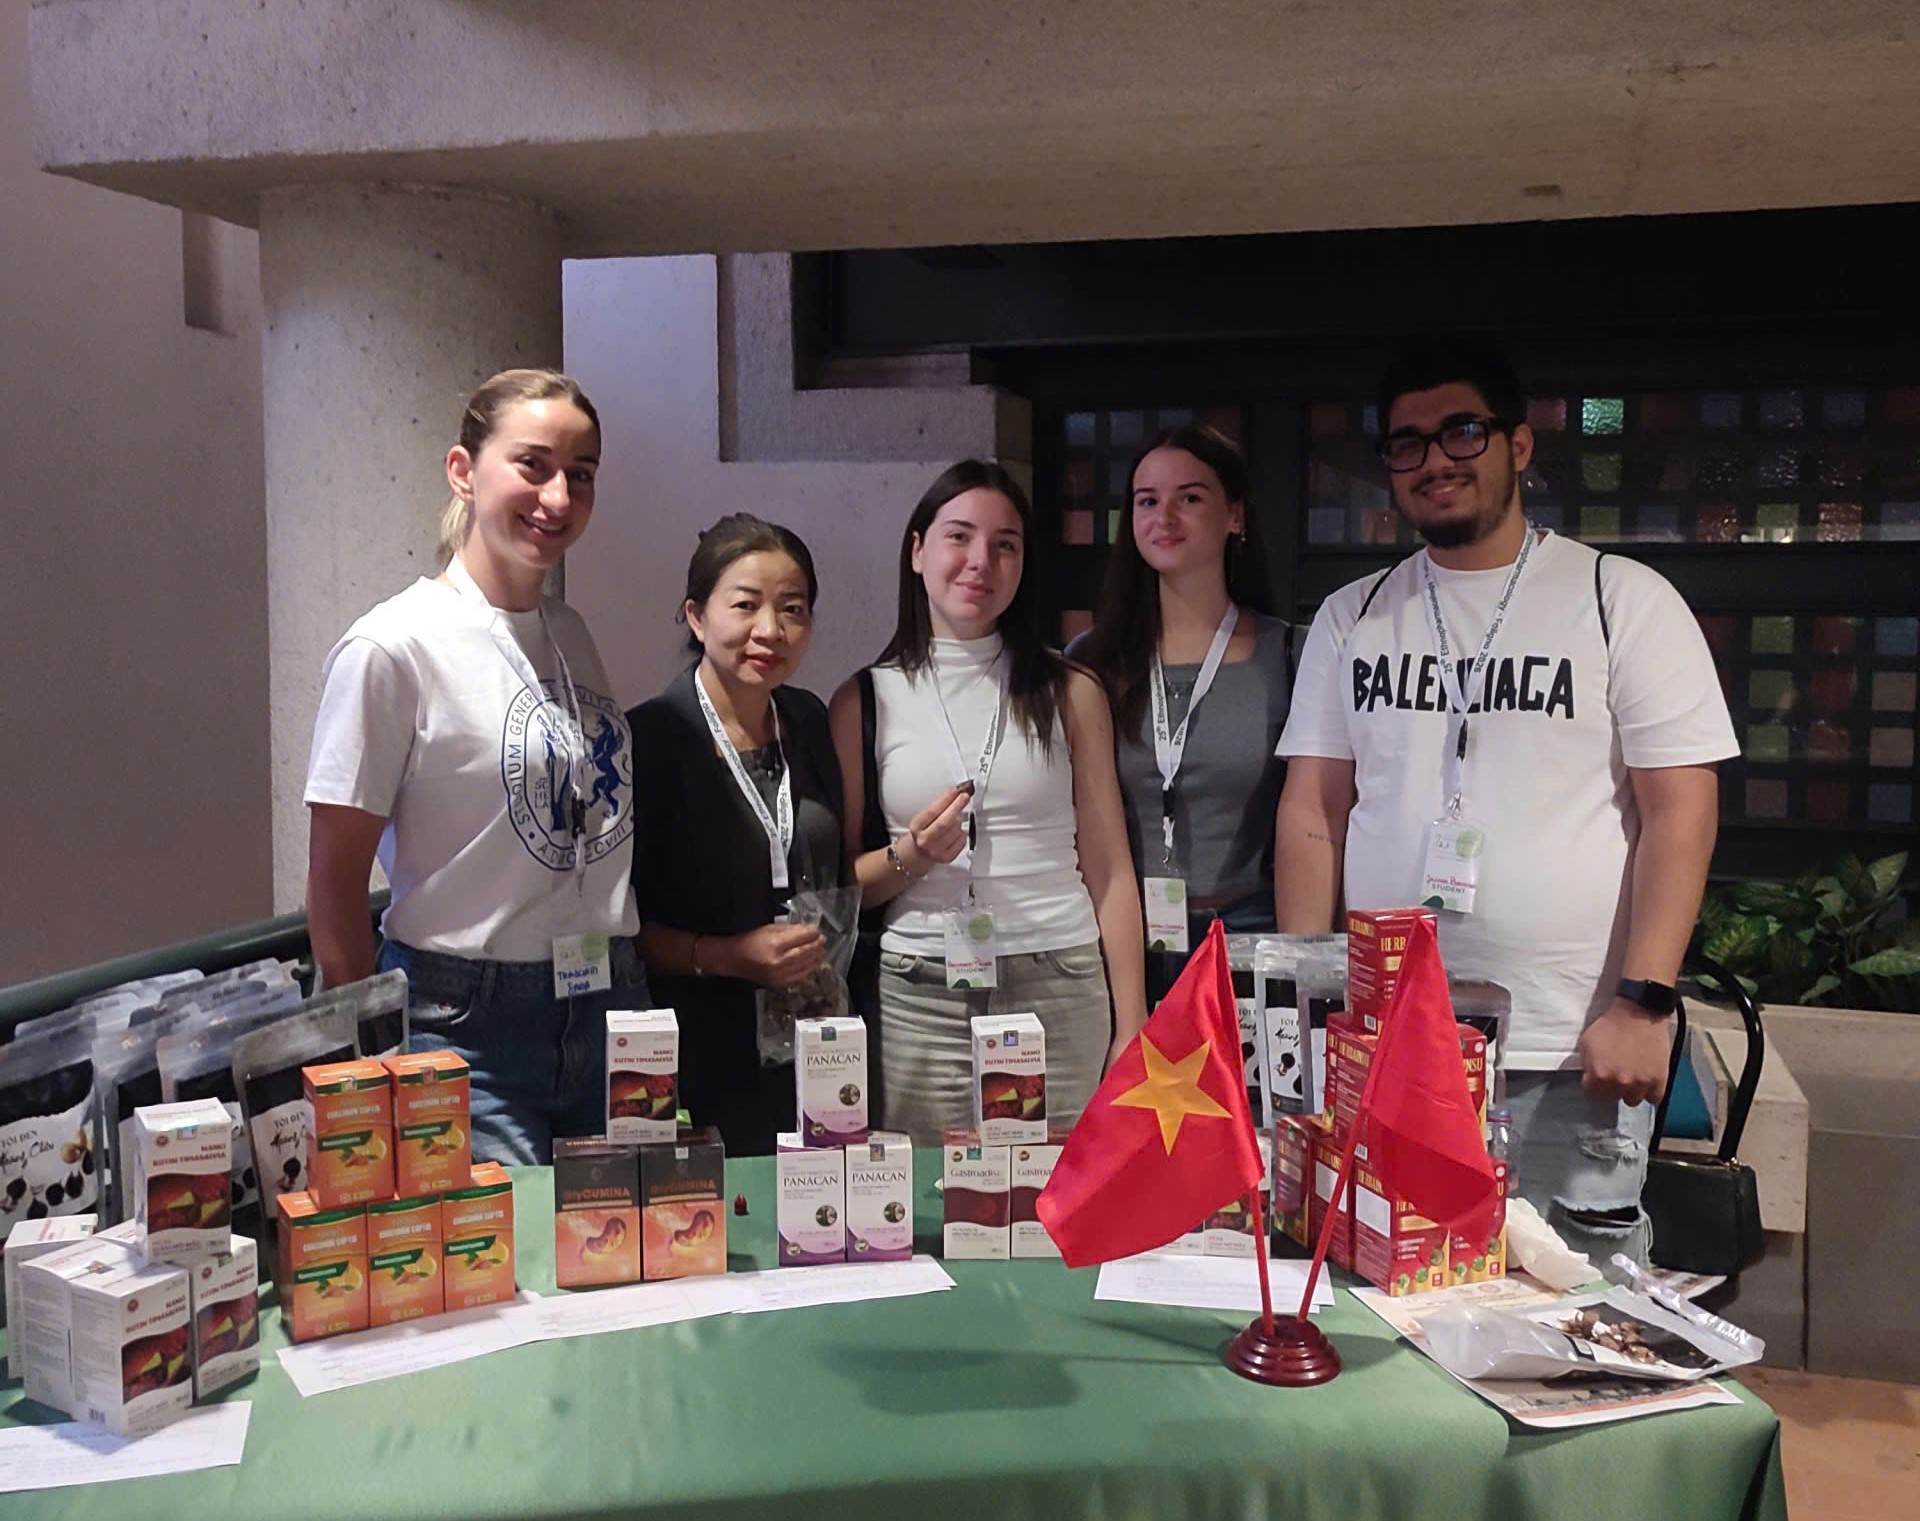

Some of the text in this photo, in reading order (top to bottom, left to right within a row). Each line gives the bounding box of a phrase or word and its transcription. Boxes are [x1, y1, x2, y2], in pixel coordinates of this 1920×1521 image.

[509, 692, 535, 736] GENER
[807, 1053, 861, 1066] PANACAN
[784, 1174, 838, 1187] PANACAN
[852, 1171, 906, 1184] PANACAN
